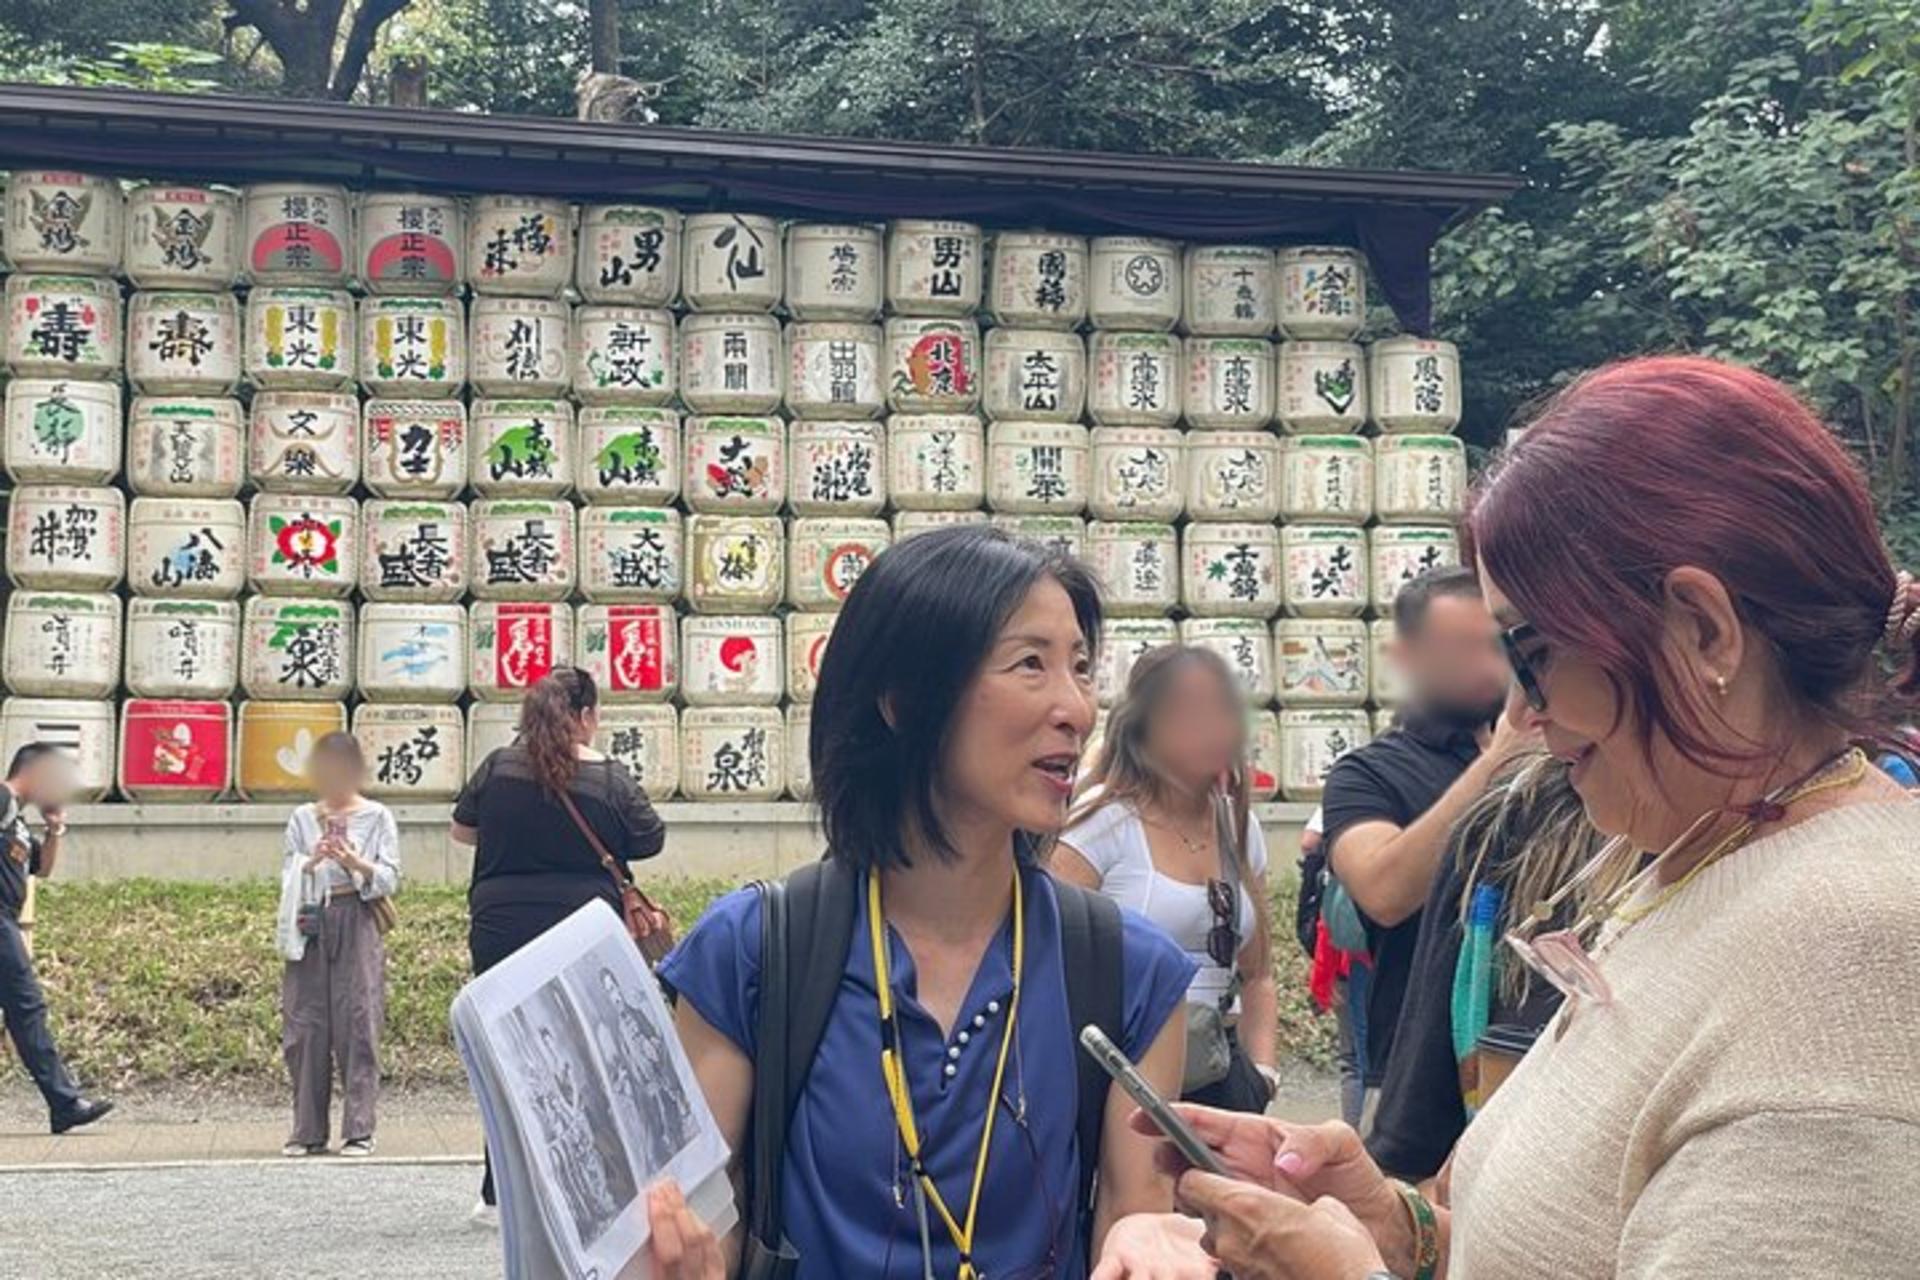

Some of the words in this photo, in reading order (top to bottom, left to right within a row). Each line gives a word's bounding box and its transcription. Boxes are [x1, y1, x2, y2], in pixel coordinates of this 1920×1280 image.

[601, 228, 663, 287] 男山
[713, 214, 764, 291] 八仙
[930, 237, 962, 296] 男山
[285, 305, 317, 369] 東光
[394, 315, 427, 379] 東光
[608, 324, 650, 388] 新政
[1023, 350, 1058, 410] 太平山
[1131, 352, 1158, 411] 高清水
[1224, 355, 1251, 415] 高清水
[400, 424, 433, 474] 力士
[30, 504, 97, 565] 加賀の井
[152, 527, 223, 587] 八海山
[379, 523, 449, 587] 長者盛
[486, 520, 555, 584] 長者盛
